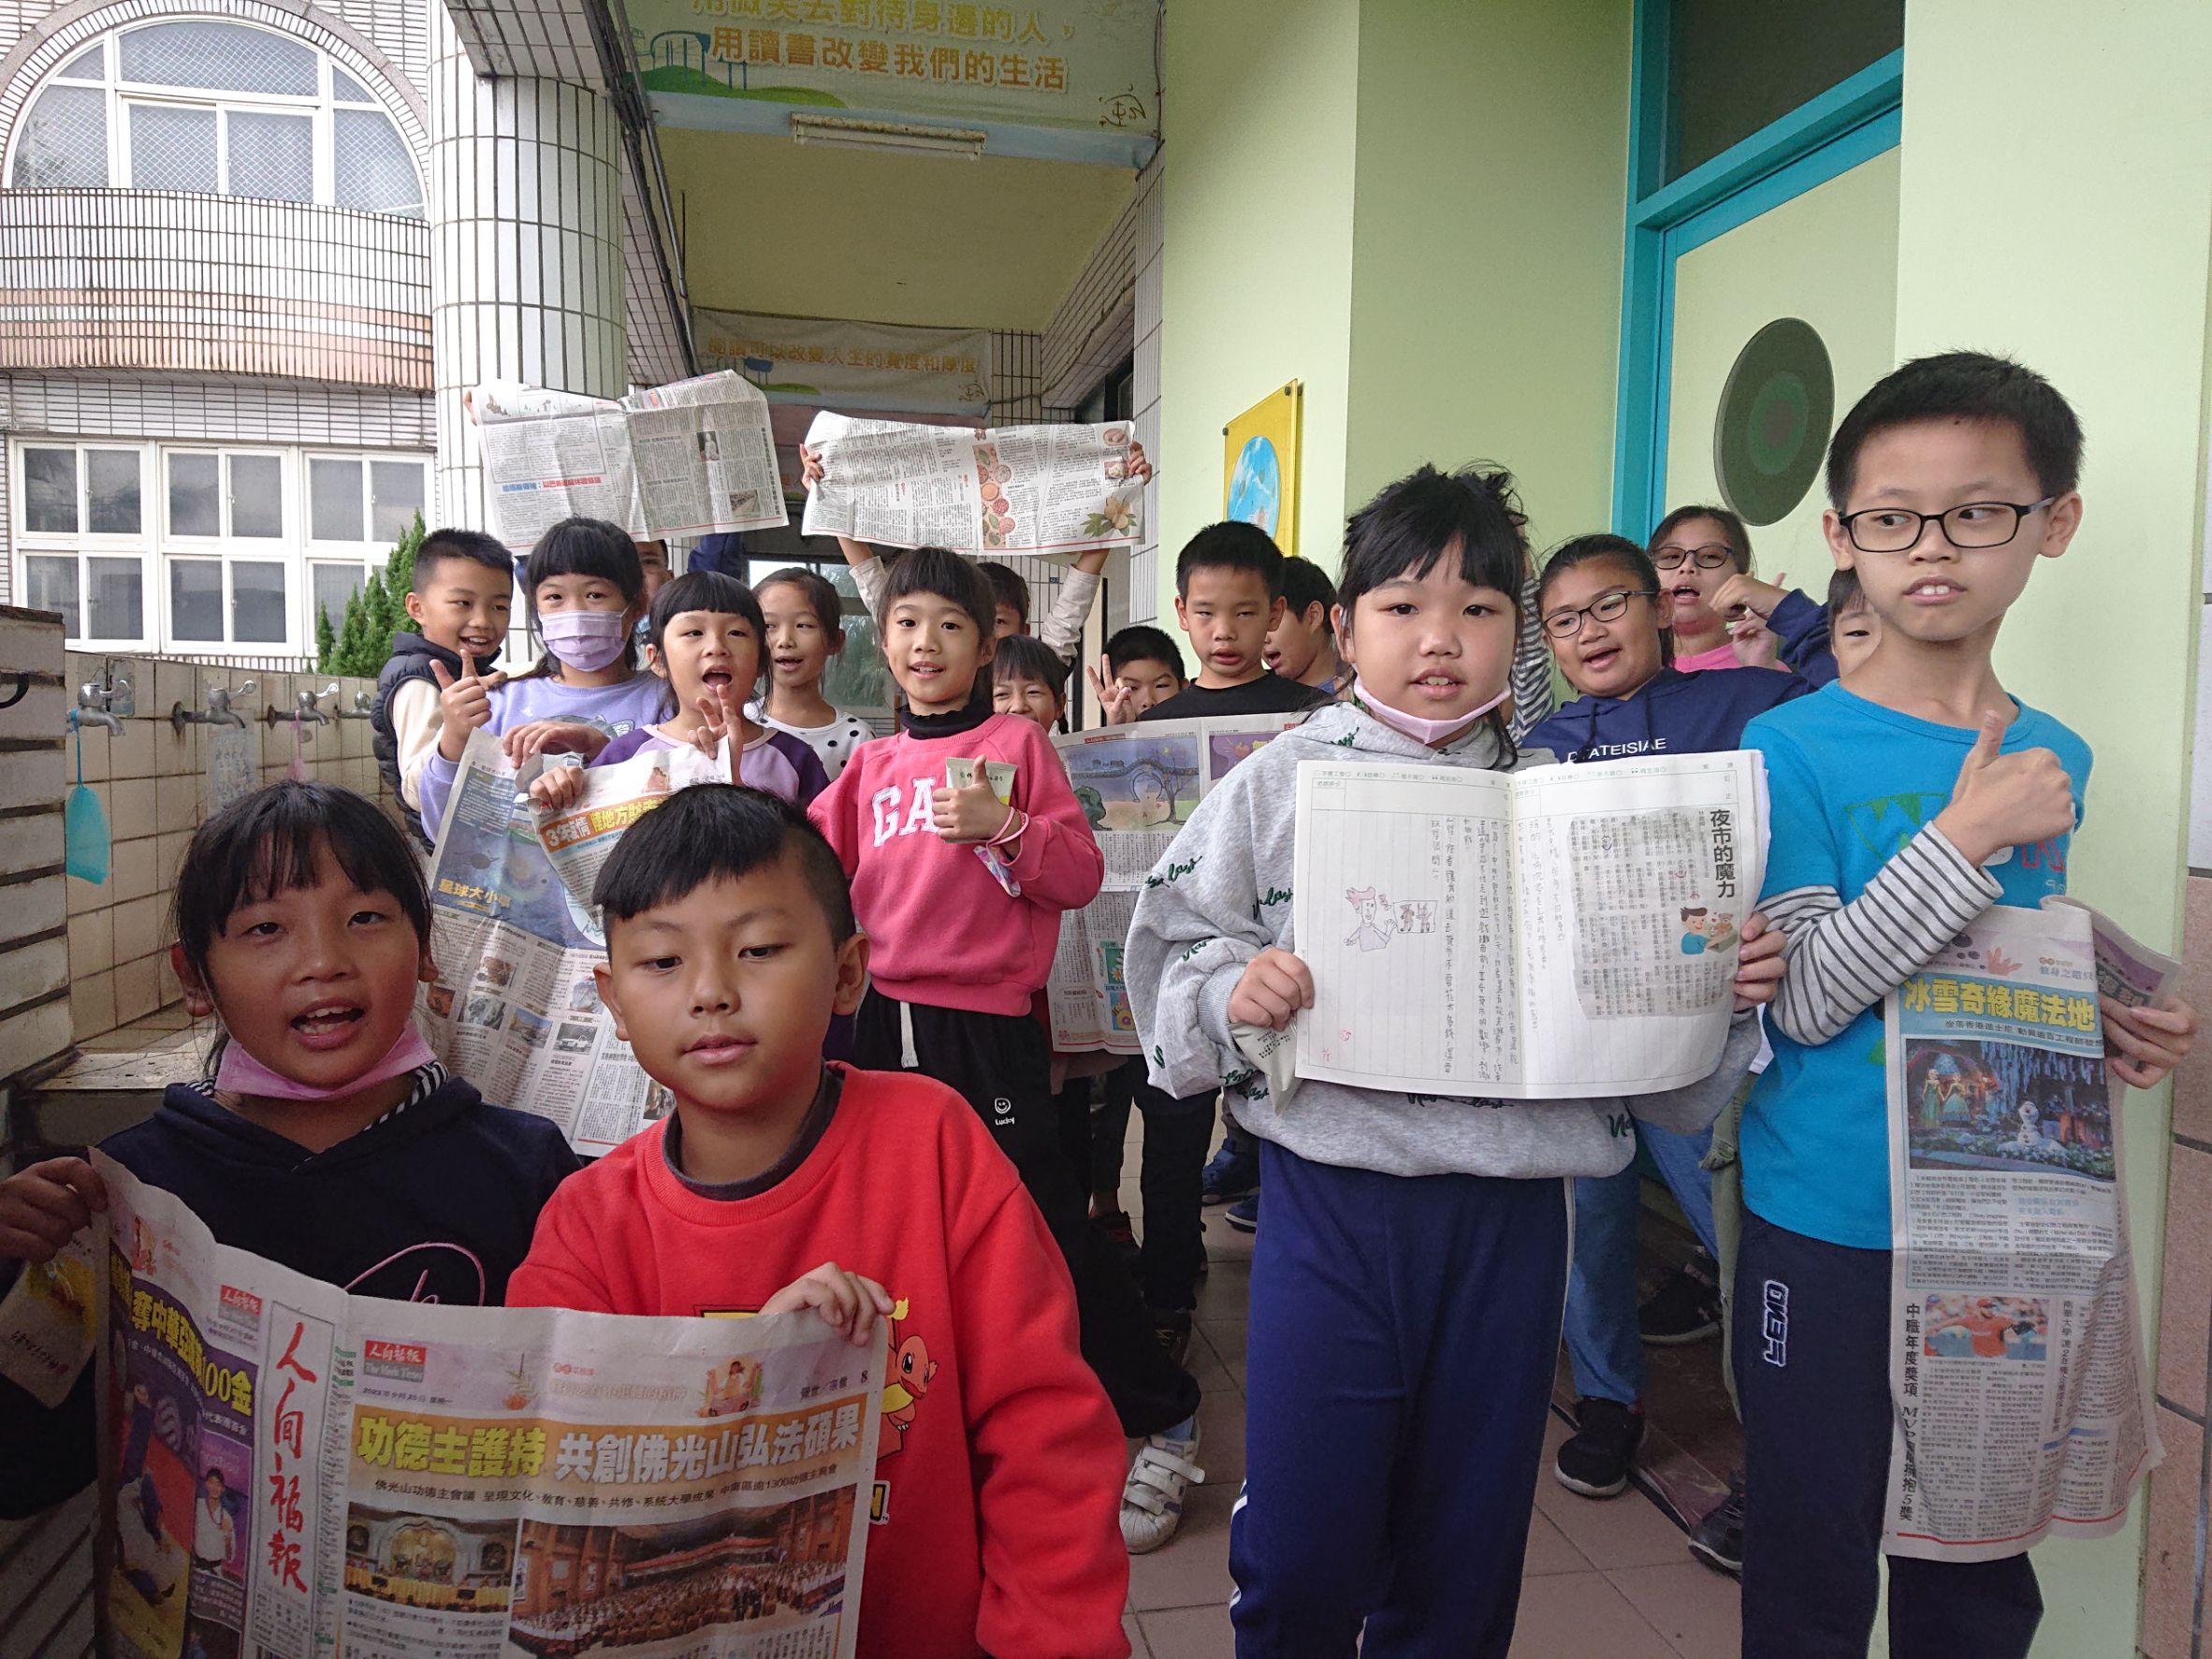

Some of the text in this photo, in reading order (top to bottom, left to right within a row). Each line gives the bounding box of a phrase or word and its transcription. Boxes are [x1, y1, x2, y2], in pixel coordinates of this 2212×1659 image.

[712, 26, 1066, 90] 用讀書改變我們的生活
[872, 776, 939, 848] GA
[1710, 808, 1737, 899] 夜市的魔力
[1904, 978, 2097, 1032] 冰雪奇緣魔法地
[995, 1116, 1015, 1125] Lucky
[369, 1346, 422, 1363] 人間福報
[860, 1369, 868, 1384] 8
[1903, 1303, 1921, 1398] 中職年度獎項
[269, 1321, 316, 1594] 人間福報
[357, 1404, 861, 1484] 功德主護持 共創佛光山弘法碩果
